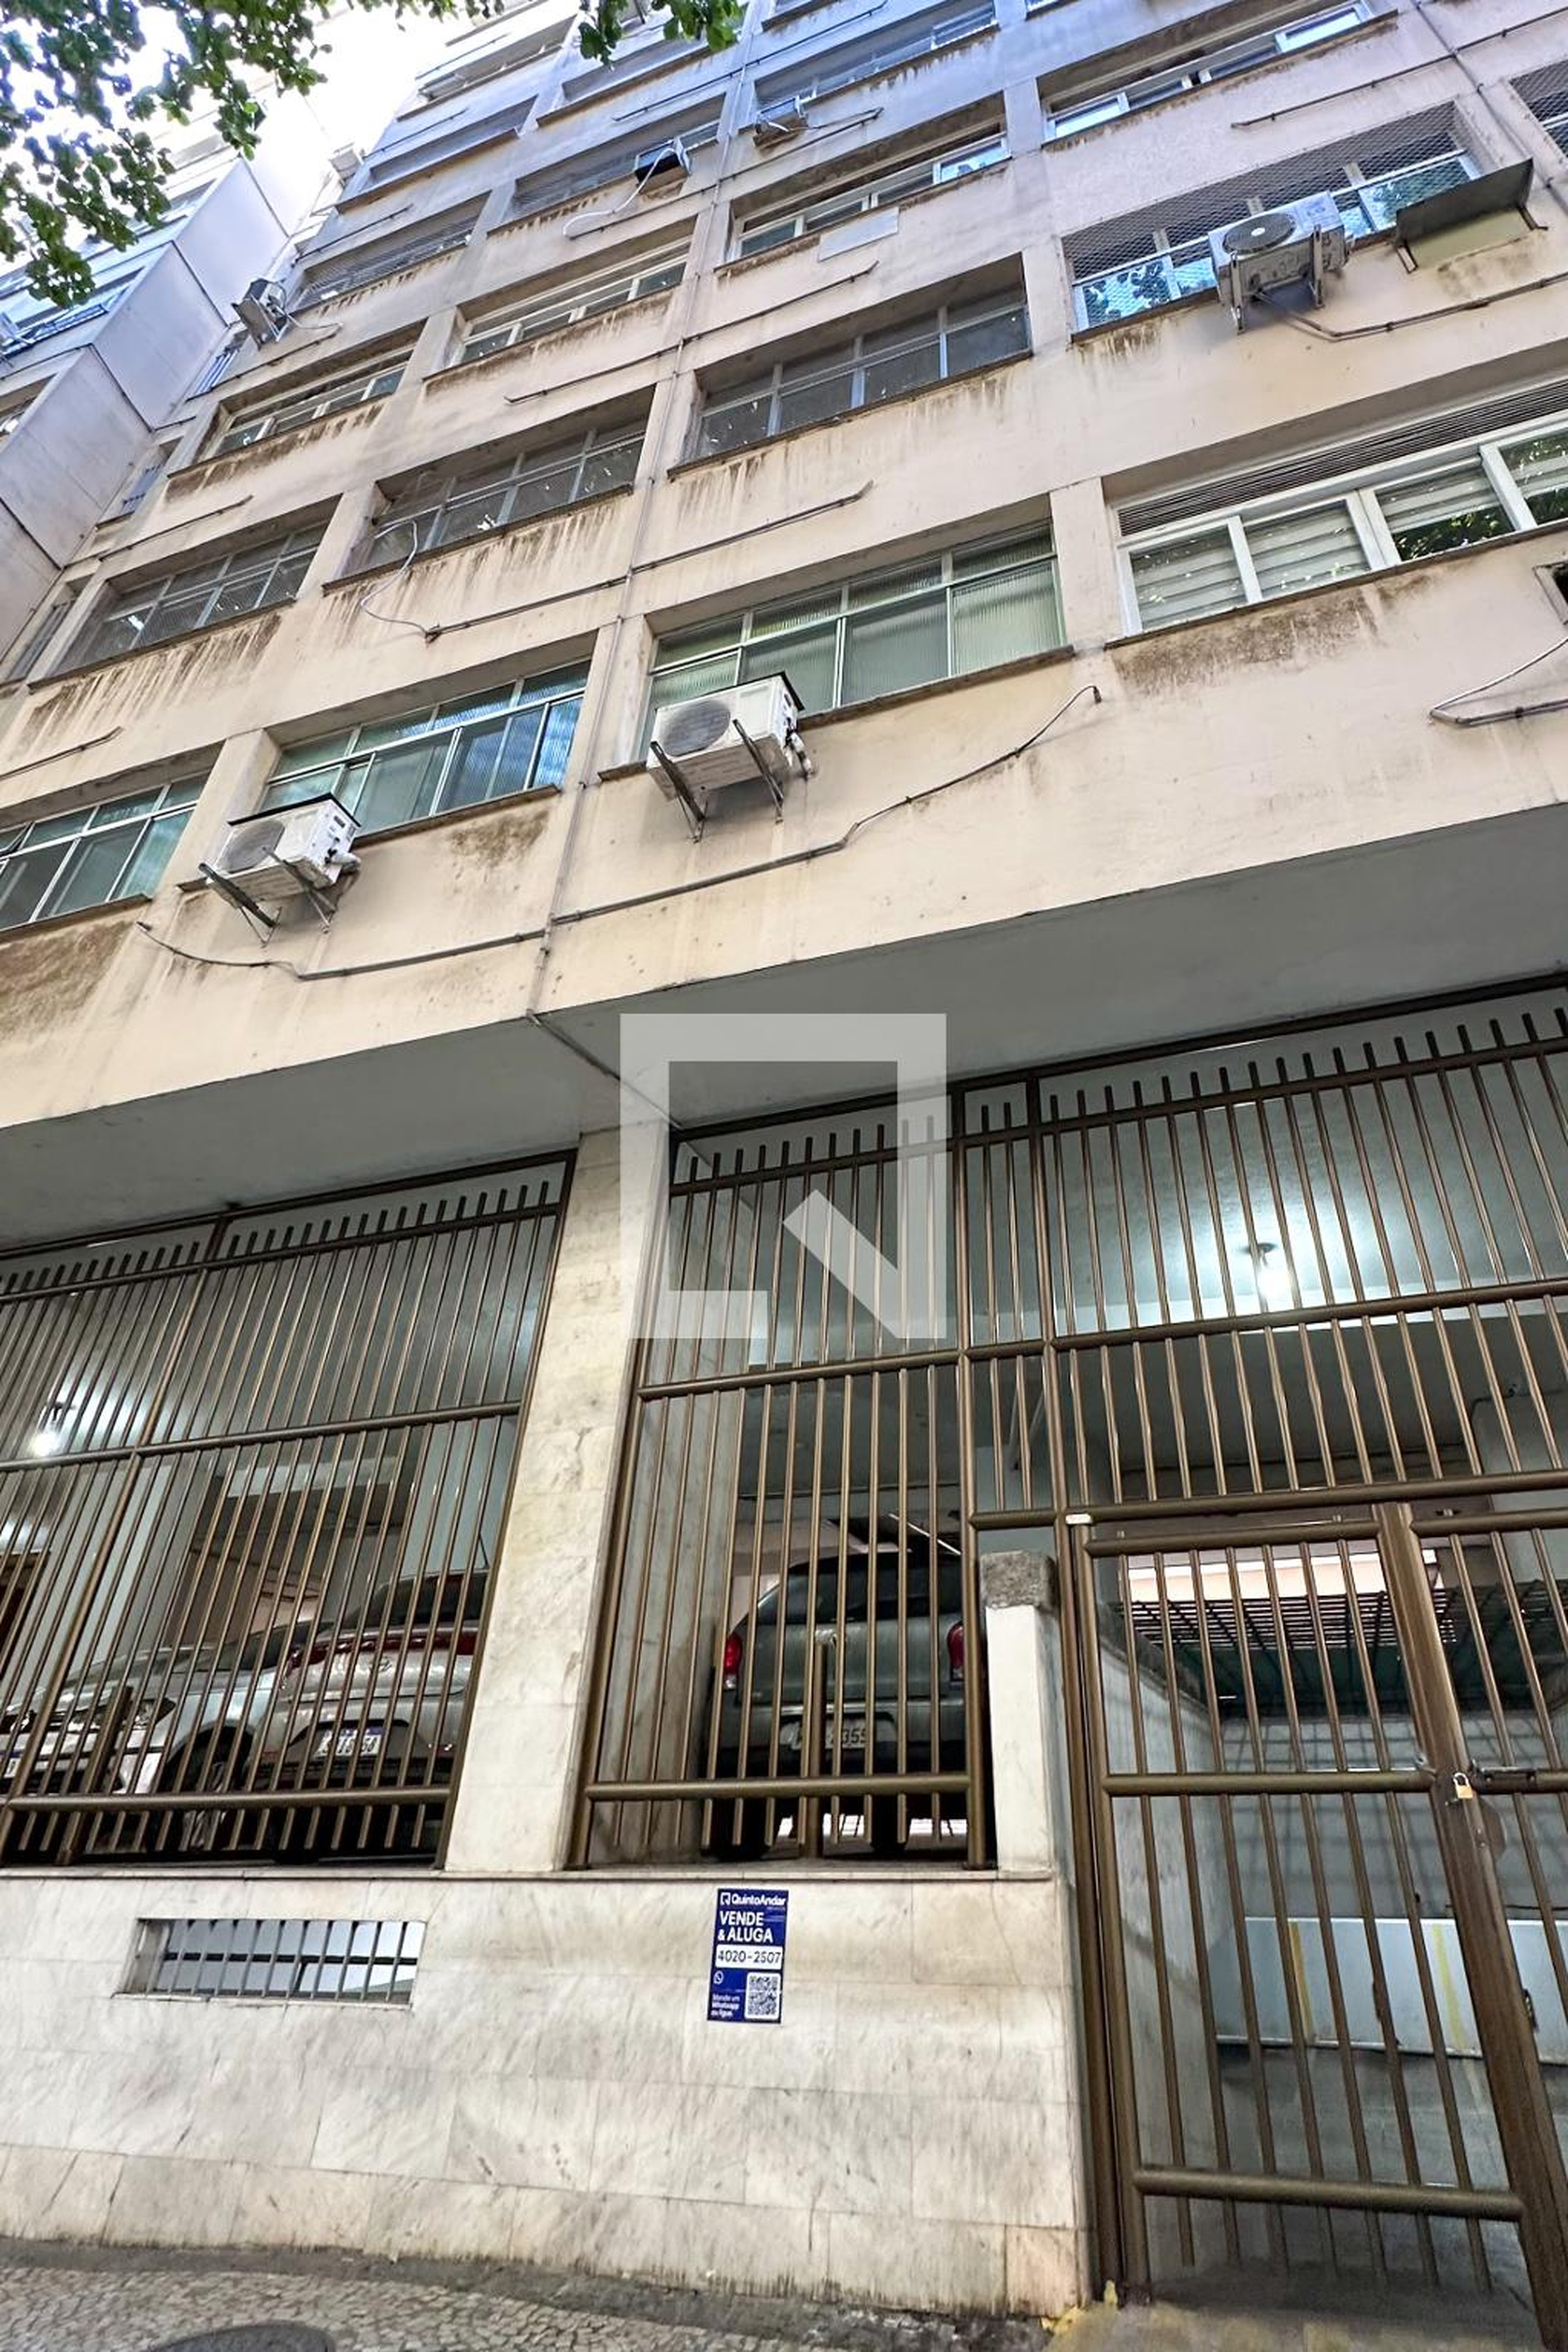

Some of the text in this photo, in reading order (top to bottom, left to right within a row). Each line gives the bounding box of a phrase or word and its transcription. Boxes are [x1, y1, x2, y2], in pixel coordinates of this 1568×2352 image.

[732, 1893, 786, 1906] QuintoAndar
[720, 1911, 764, 1926] VENDE
[718, 1927, 773, 1943] & ALUGA
